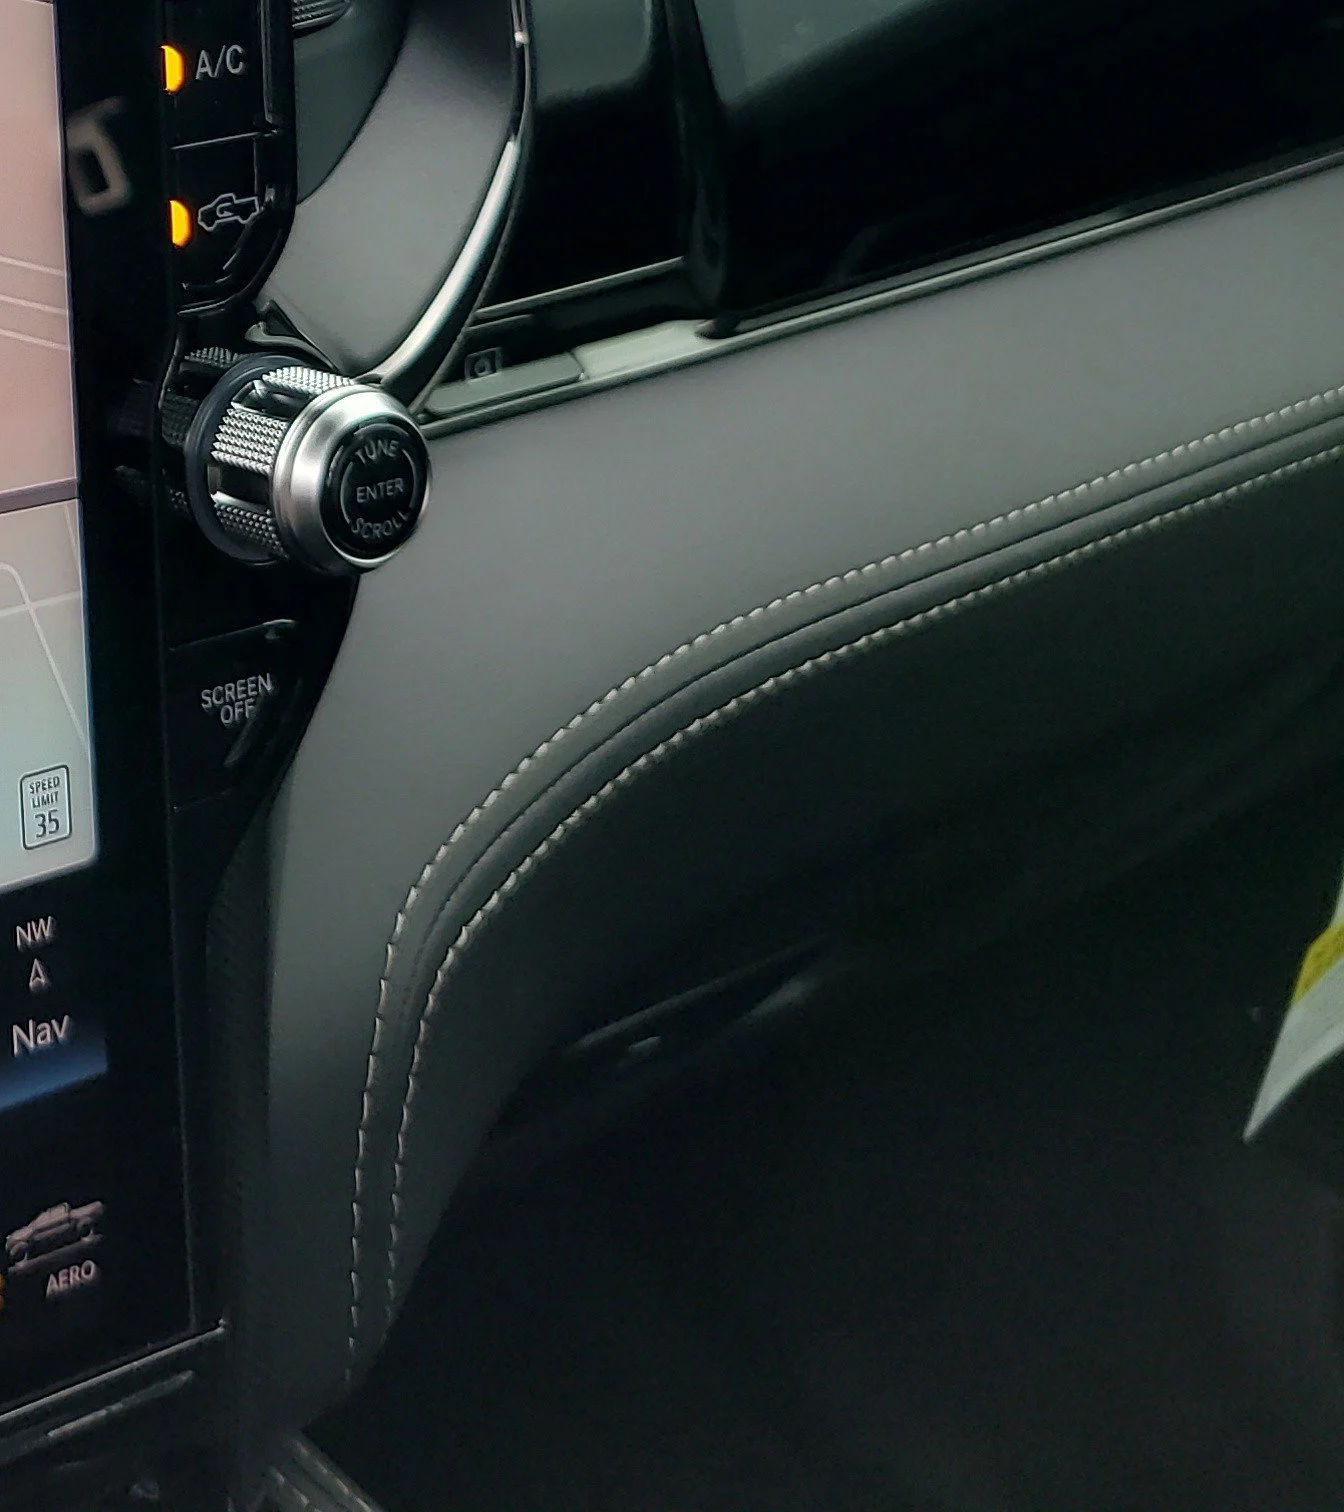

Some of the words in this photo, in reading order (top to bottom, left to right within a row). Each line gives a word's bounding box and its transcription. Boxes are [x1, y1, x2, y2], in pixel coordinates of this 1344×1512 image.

[195, 44, 246, 80] A/C
[354, 439, 400, 464] TUNE
[356, 477, 404, 503] ENTER
[351, 509, 409, 538] SCROLL
[201, 672, 273, 710] SCREEN
[219, 700, 256, 728] OFF
[29, 775, 60, 794] SPEED
[31, 790, 59, 808] LIMIT
[34, 808, 60, 838] 35
[16, 915, 53, 949] NW
[12, 1014, 71, 1058] Nav
[45, 1259, 97, 1298] AERO
